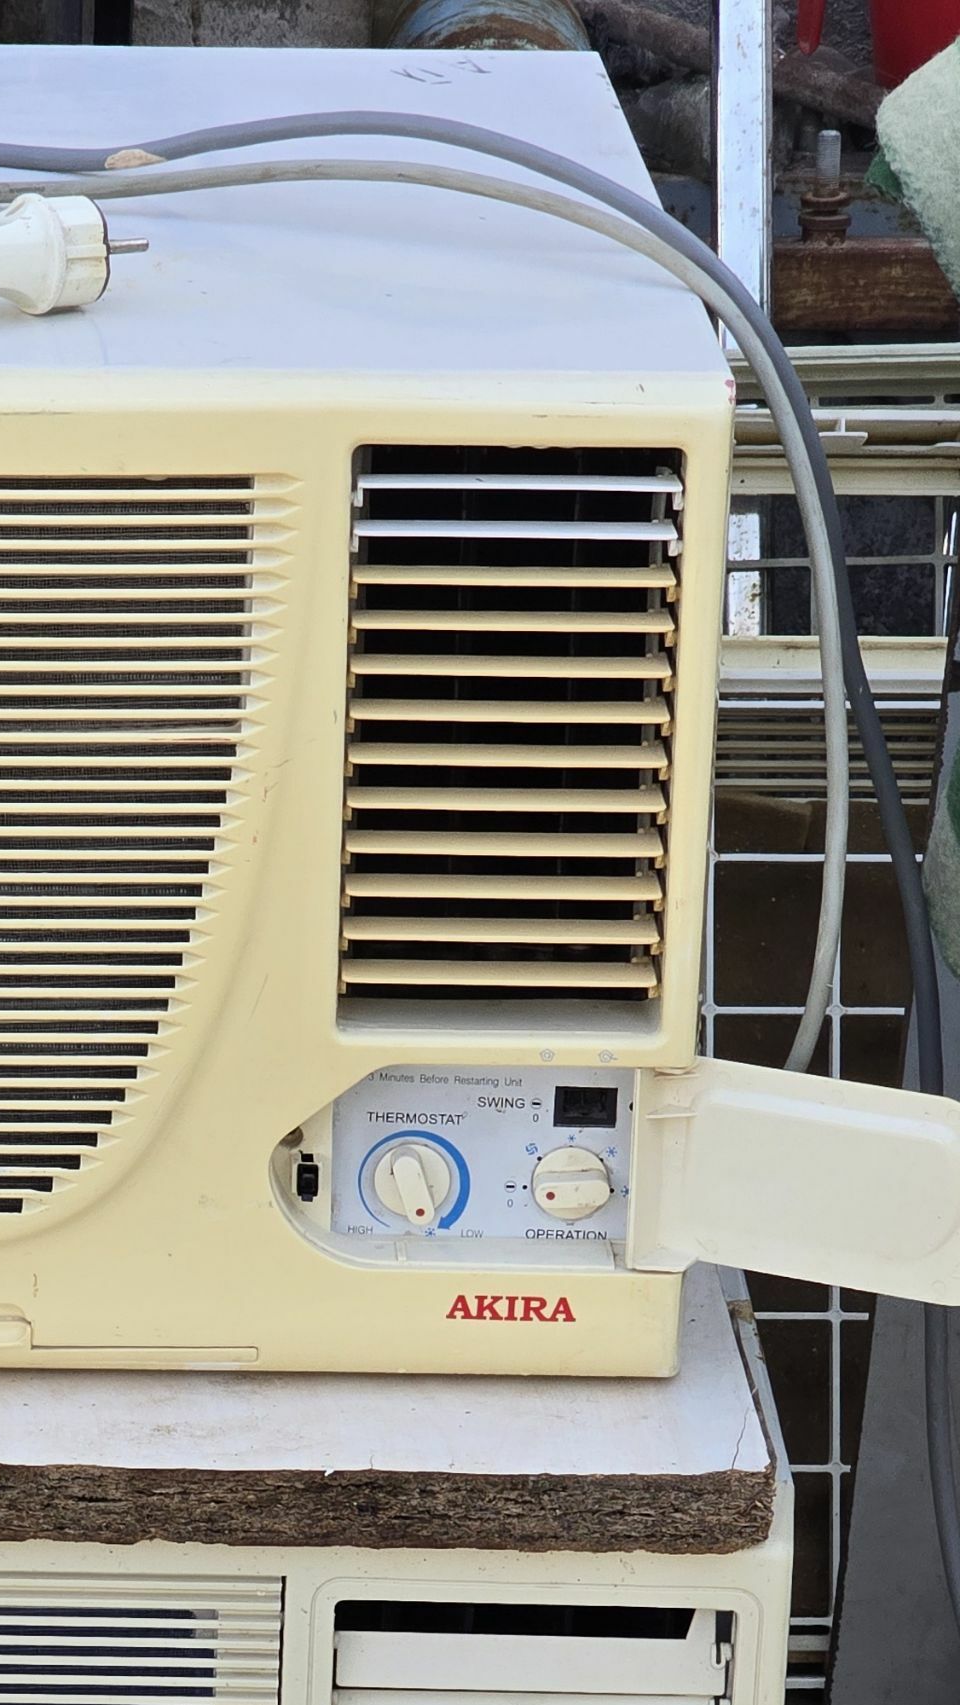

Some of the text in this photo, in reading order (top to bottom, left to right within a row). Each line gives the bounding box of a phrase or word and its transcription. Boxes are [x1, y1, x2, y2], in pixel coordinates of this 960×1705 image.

[379, 1072, 415, 1084] Minutes
[419, 1073, 450, 1085] Before
[454, 1075, 500, 1089] Restarting
[504, 1077, 523, 1087] Unit
[477, 1096, 526, 1109] SWING
[367, 1111, 464, 1126] THERMOSTAT
[347, 1225, 374, 1236] HIGH
[460, 1228, 484, 1239] LOW
[525, 1228, 608, 1240] OPERATION
[445, 1294, 577, 1322] AKIRA
